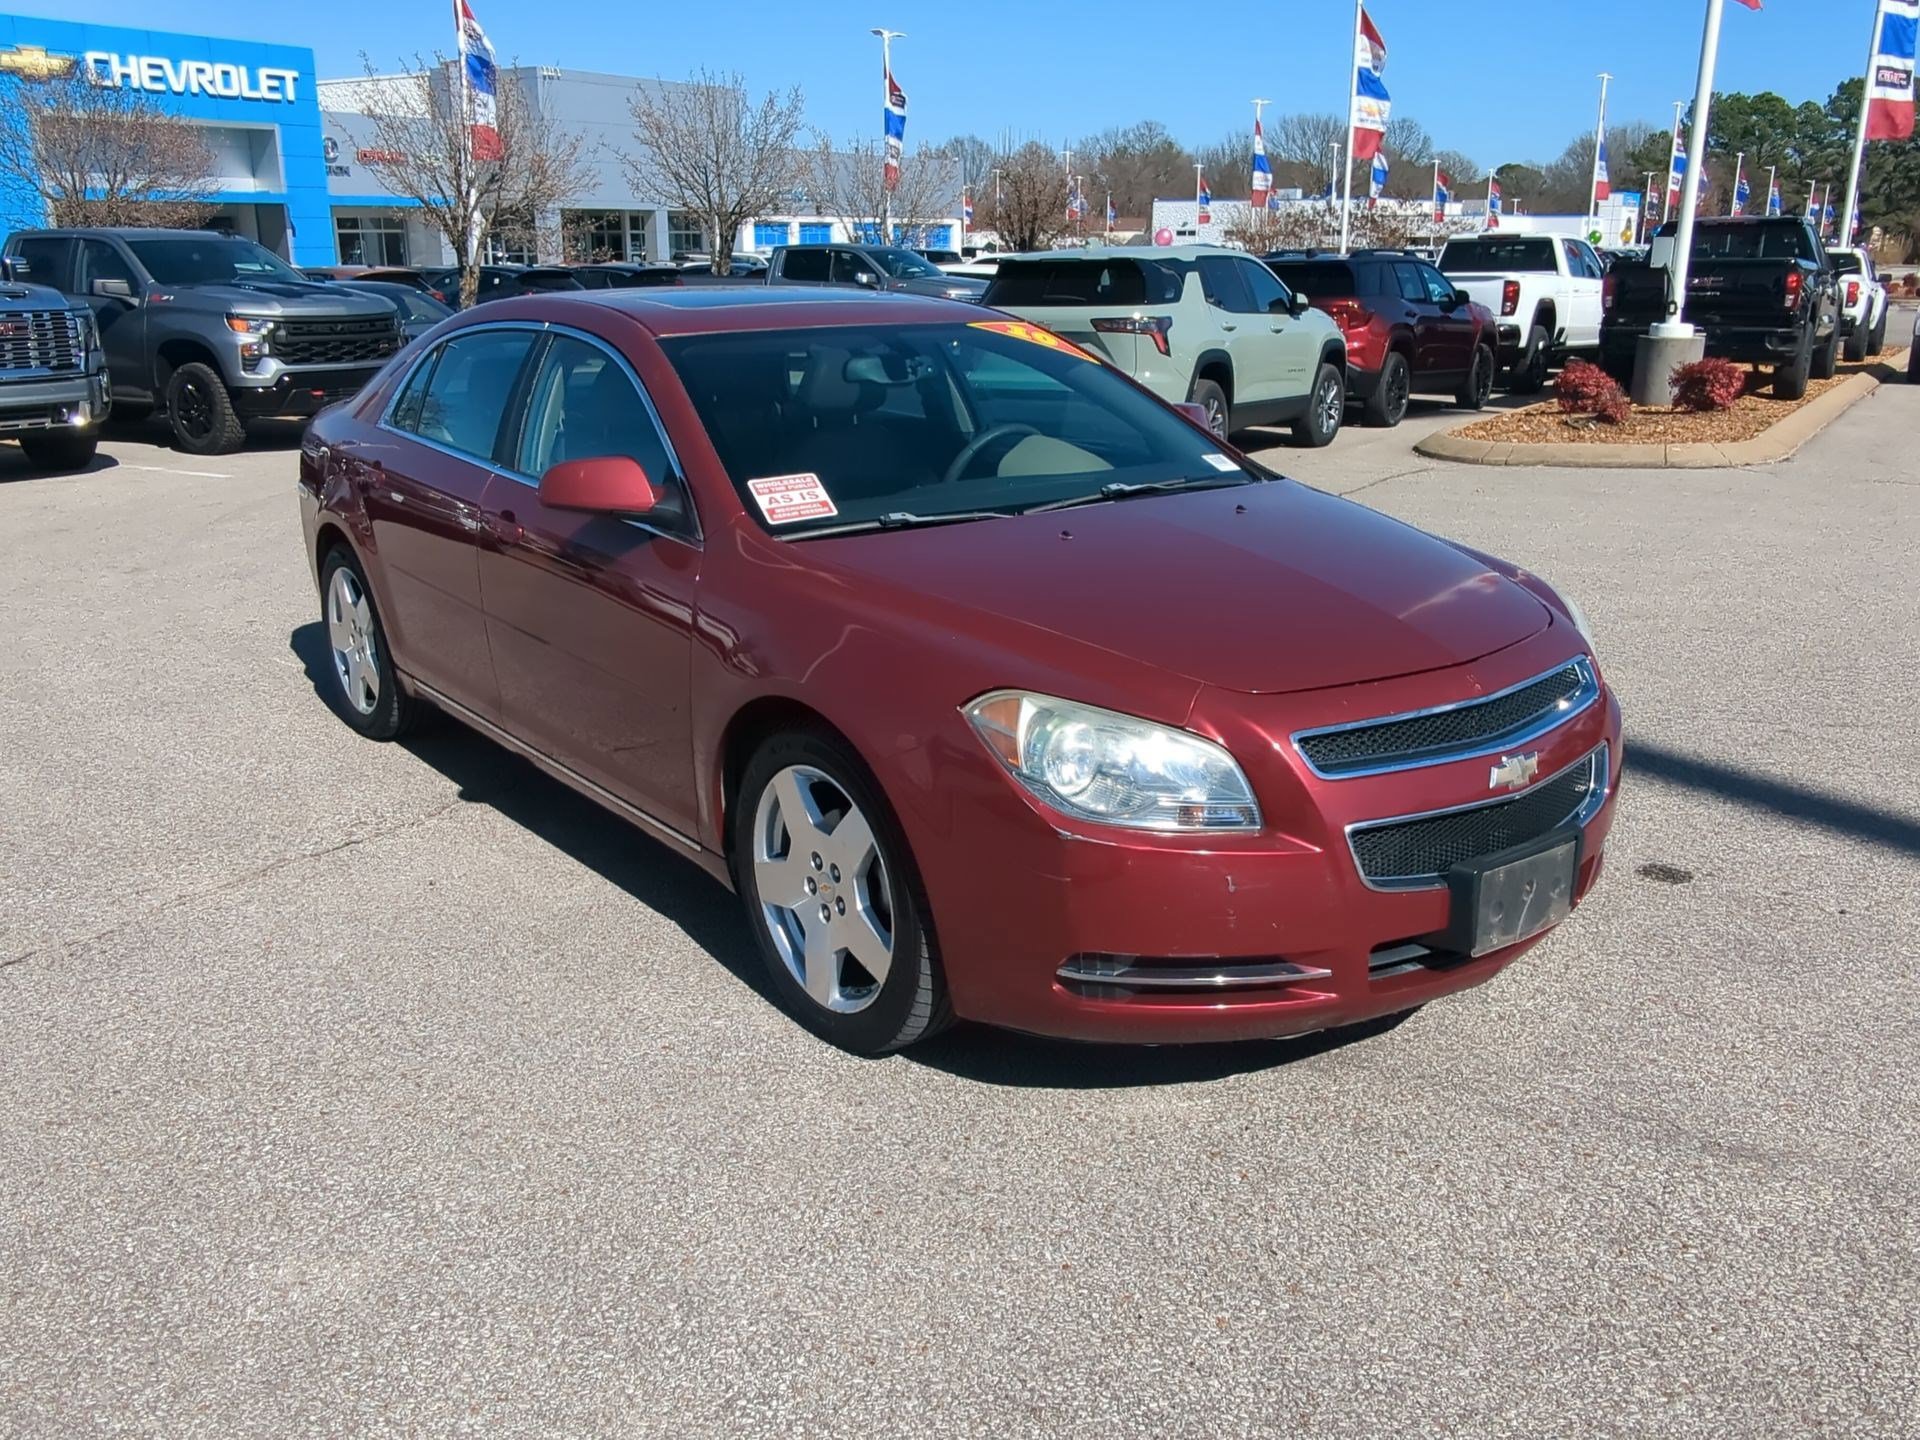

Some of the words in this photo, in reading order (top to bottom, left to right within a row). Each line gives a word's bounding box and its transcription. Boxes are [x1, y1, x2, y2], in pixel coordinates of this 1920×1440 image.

[85, 51, 299, 103] CHEVROLET
[754, 476, 814, 488] WHOLESALE
[788, 482, 817, 490] PUBLIC
[768, 494, 793, 505] AS
[799, 490, 819, 501] IS
